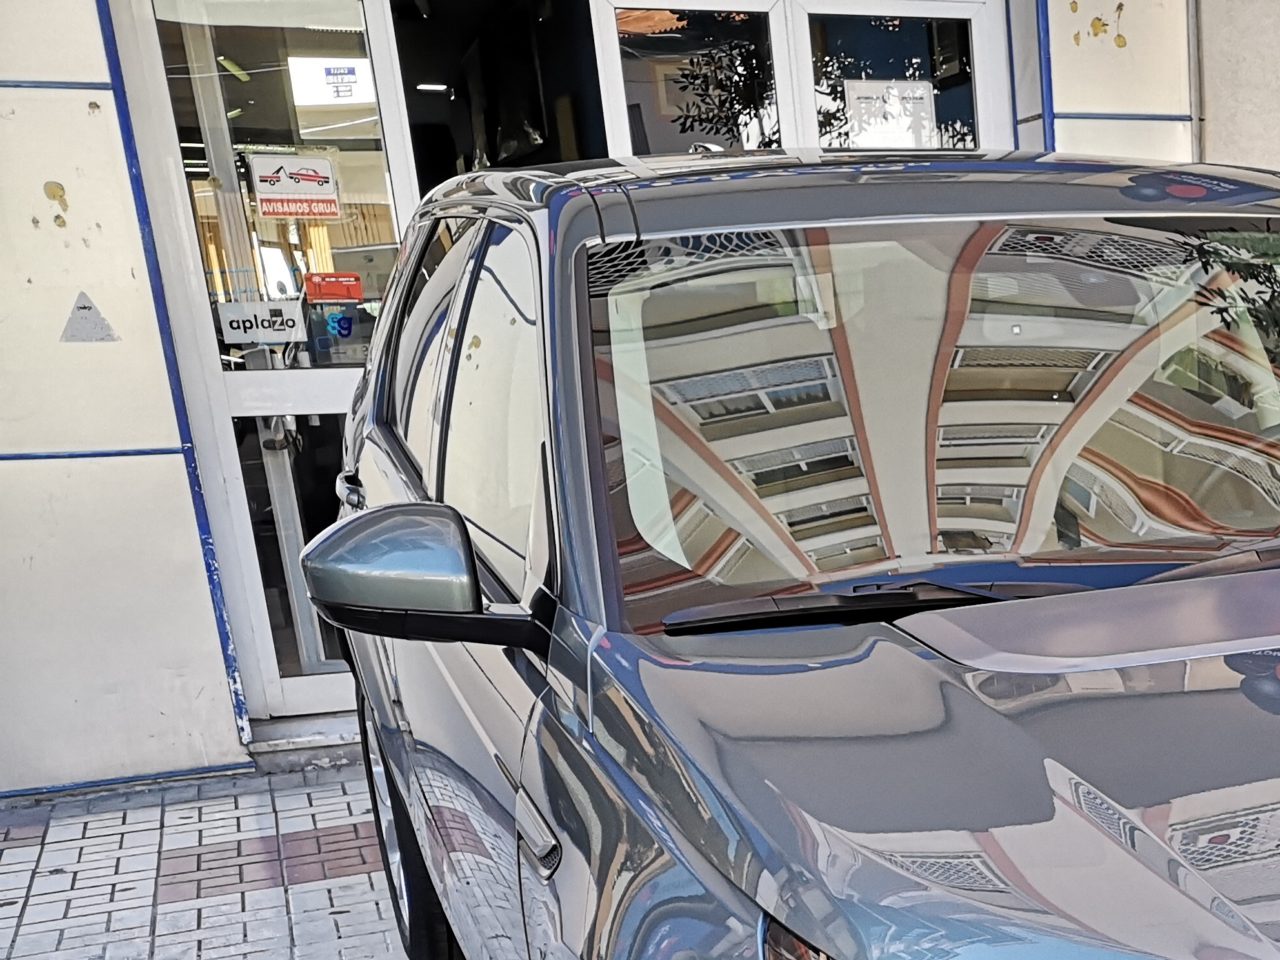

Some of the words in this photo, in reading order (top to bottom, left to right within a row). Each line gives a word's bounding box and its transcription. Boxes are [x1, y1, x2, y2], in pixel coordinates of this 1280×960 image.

[262, 201, 310, 213] AVISAMOS
[311, 201, 338, 213] GRUA
[229, 312, 296, 334] aplazo
